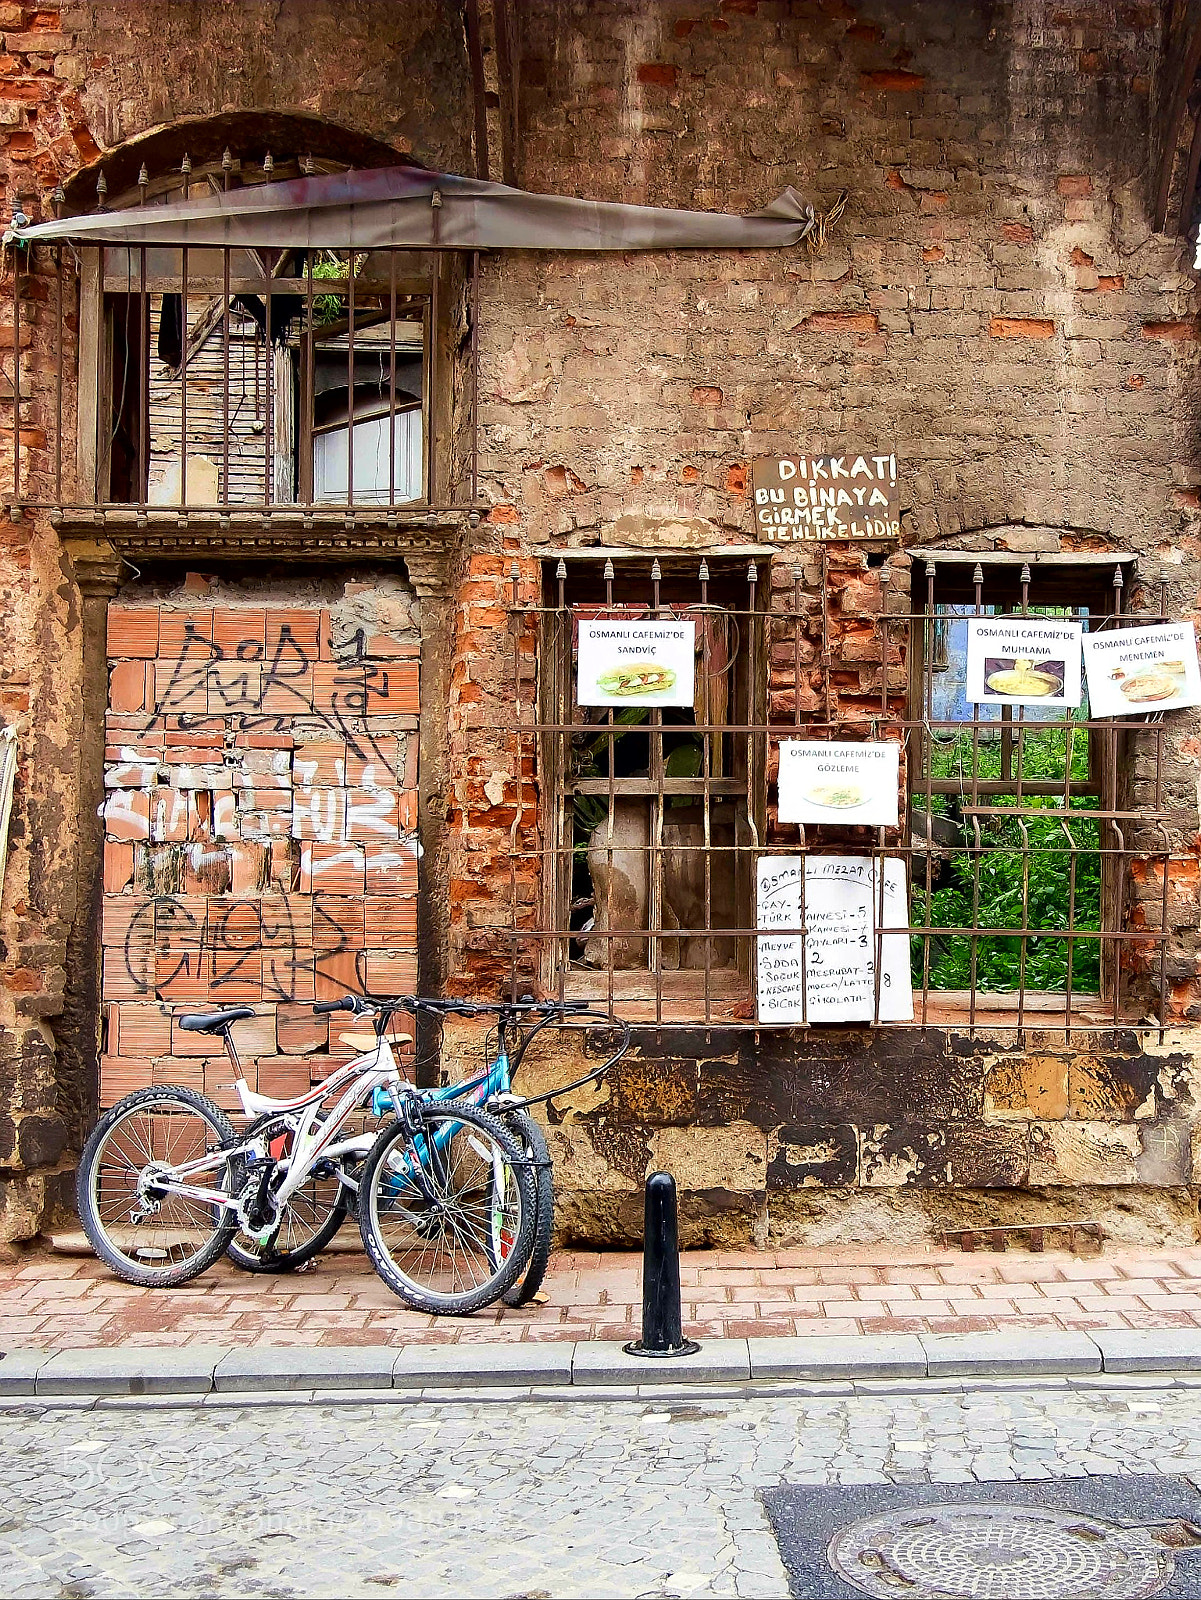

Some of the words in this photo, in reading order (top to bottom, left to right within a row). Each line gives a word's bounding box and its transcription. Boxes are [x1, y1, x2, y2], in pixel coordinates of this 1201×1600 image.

[778, 453, 897, 487] DİKKAT!
[755, 488, 786, 505] BU
[793, 480, 889, 507] BİNAYA
[758, 506, 843, 525] GİRMEK
[589, 630, 630, 639] OSMANLI
[976, 628, 1019, 638] OSMANLI
[617, 645, 657, 656] SANDVİÇ
[1093, 638, 1133, 650] OSMANLI
[1119, 650, 1165, 662] MENEMEN
[790, 749, 831, 758] OSMANLI
[817, 763, 860, 773] GÖZLEME
[867, 868, 898, 893] CFE
[858, 905, 867, 919] 5
[761, 942, 797, 953] MEYVE
[858, 935, 868, 948] 3
[811, 952, 824, 965] 2
[883, 973, 891, 988] 8
